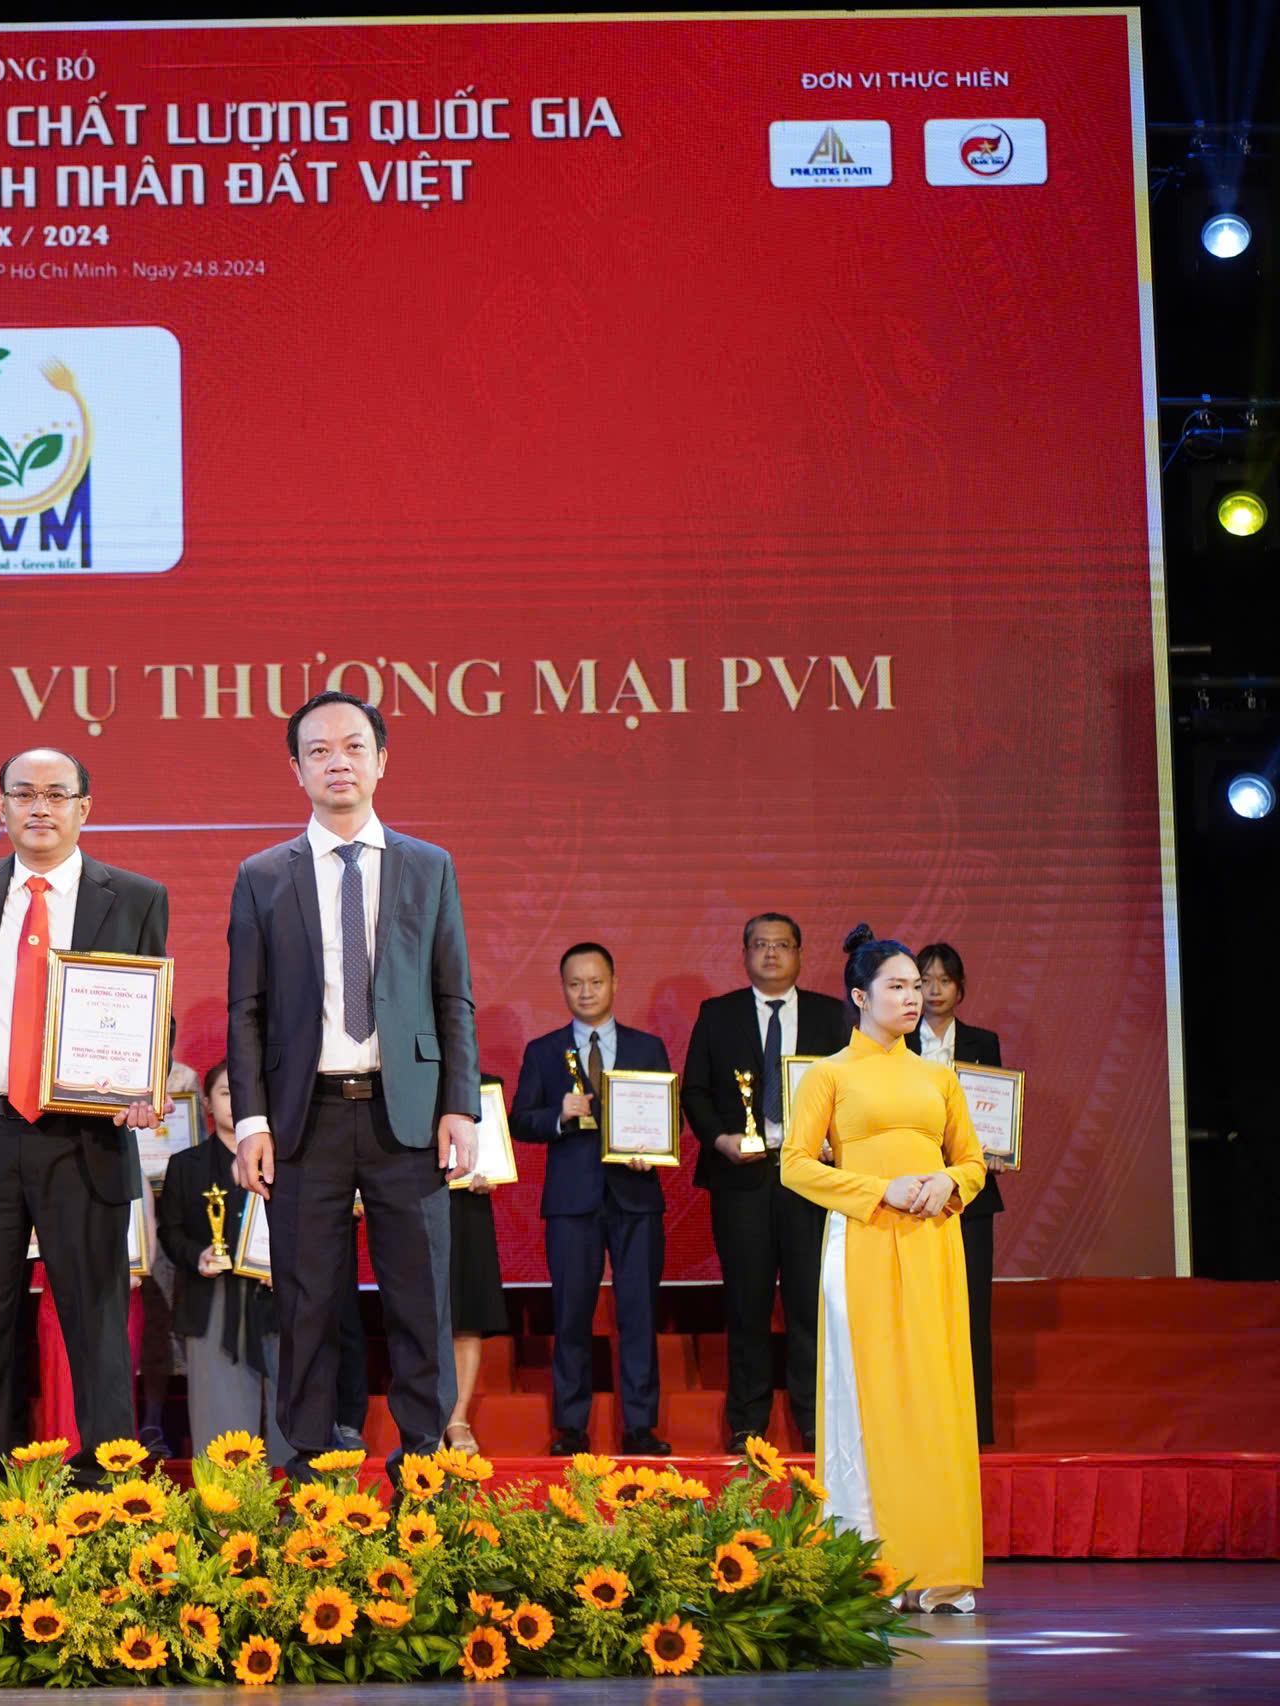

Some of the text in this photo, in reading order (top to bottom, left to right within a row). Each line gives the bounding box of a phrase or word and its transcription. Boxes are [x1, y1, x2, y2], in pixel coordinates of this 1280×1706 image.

[801, 67, 1009, 91] ĐƠN VỊ THỰC HIỆN
[7, 92, 146, 146] CHẤT
[167, 101, 348, 150] LƯỢNG
[370, 86, 509, 144] QUỐC
[531, 97, 621, 138] GIA
[57, 156, 204, 206] NHÂN
[224, 149, 337, 204] ĐẤT
[359, 151, 472, 209] VIỆT
[843, 166, 872, 175] NAM
[21, 226, 34, 246] /
[43, 225, 109, 246] 2024
[73, 260, 117, 278] Minh
[183, 259, 265, 278] 24.8.2024
[22, 559, 55, 569] Green
[11, 666, 116, 736] VỤ
[144, 652, 502, 719] THƯƠNG
[534, 659, 687, 729] MẠI
[722, 656, 894, 712] PVM
